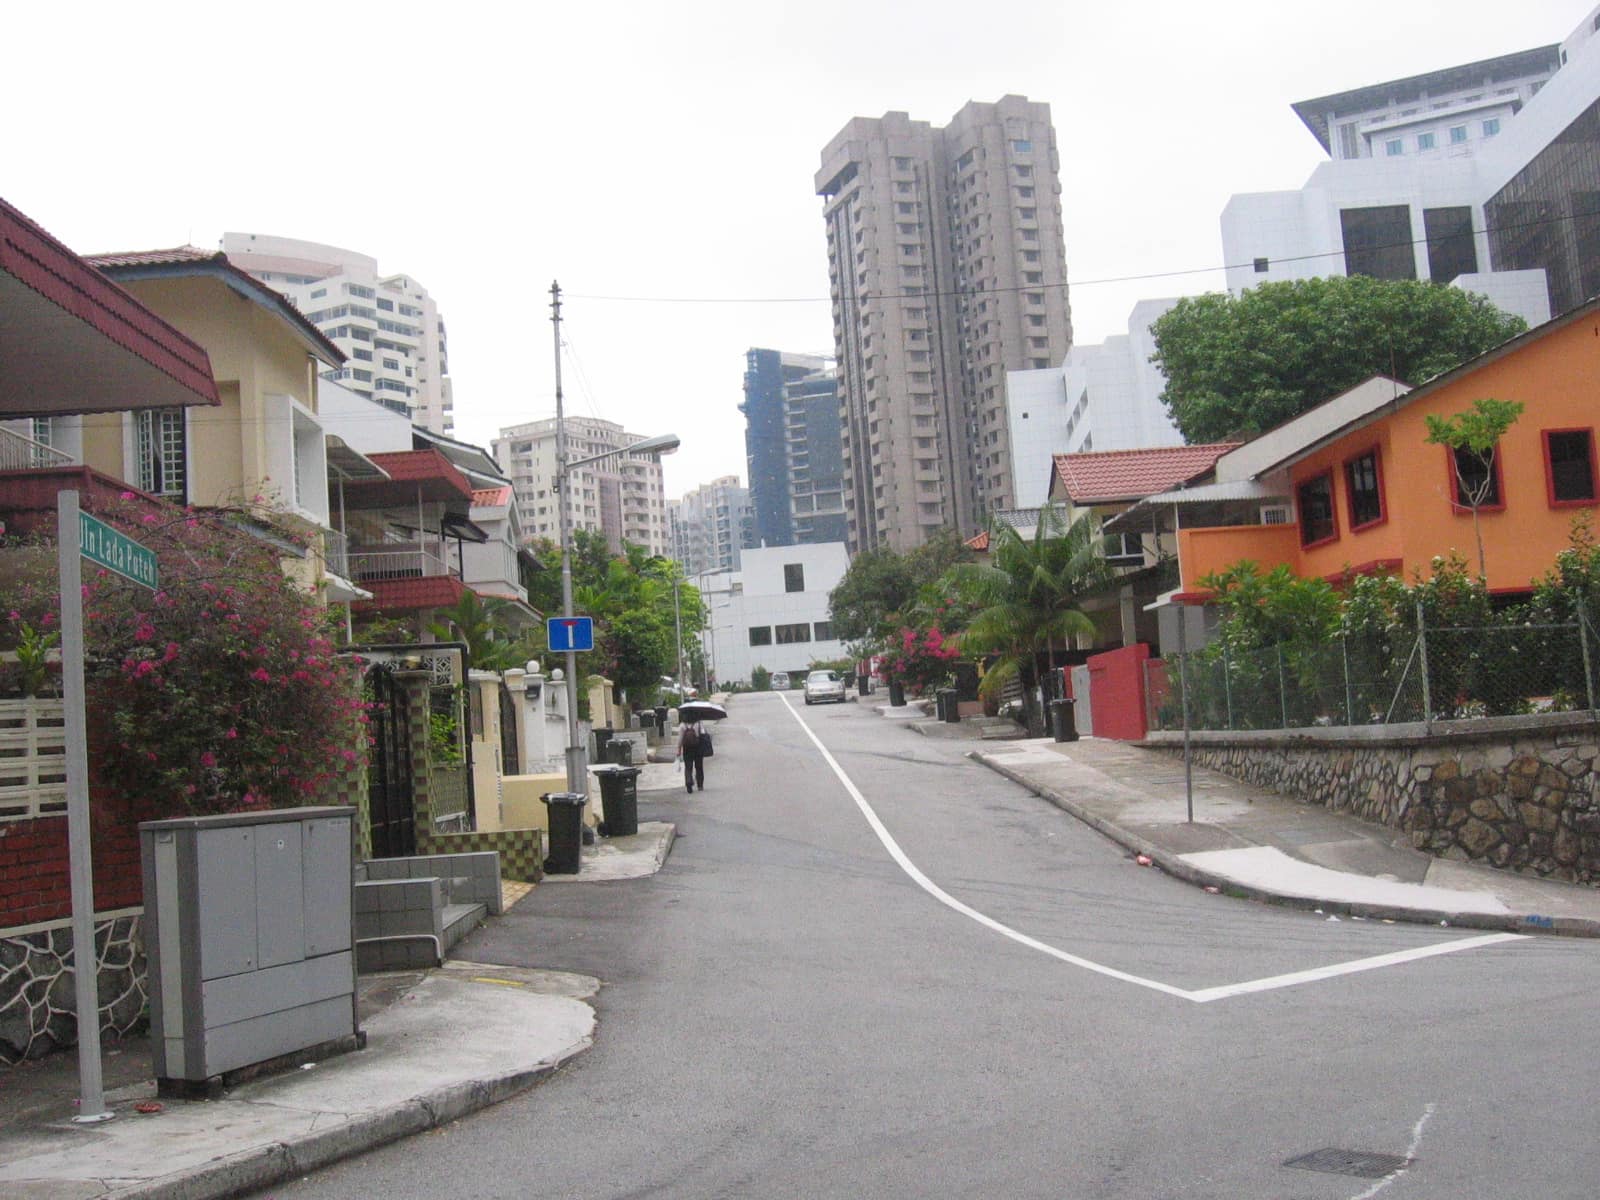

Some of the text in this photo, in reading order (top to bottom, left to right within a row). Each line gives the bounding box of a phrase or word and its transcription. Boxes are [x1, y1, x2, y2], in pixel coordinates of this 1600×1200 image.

[80, 517, 154, 583] Jln Lada Puteh
